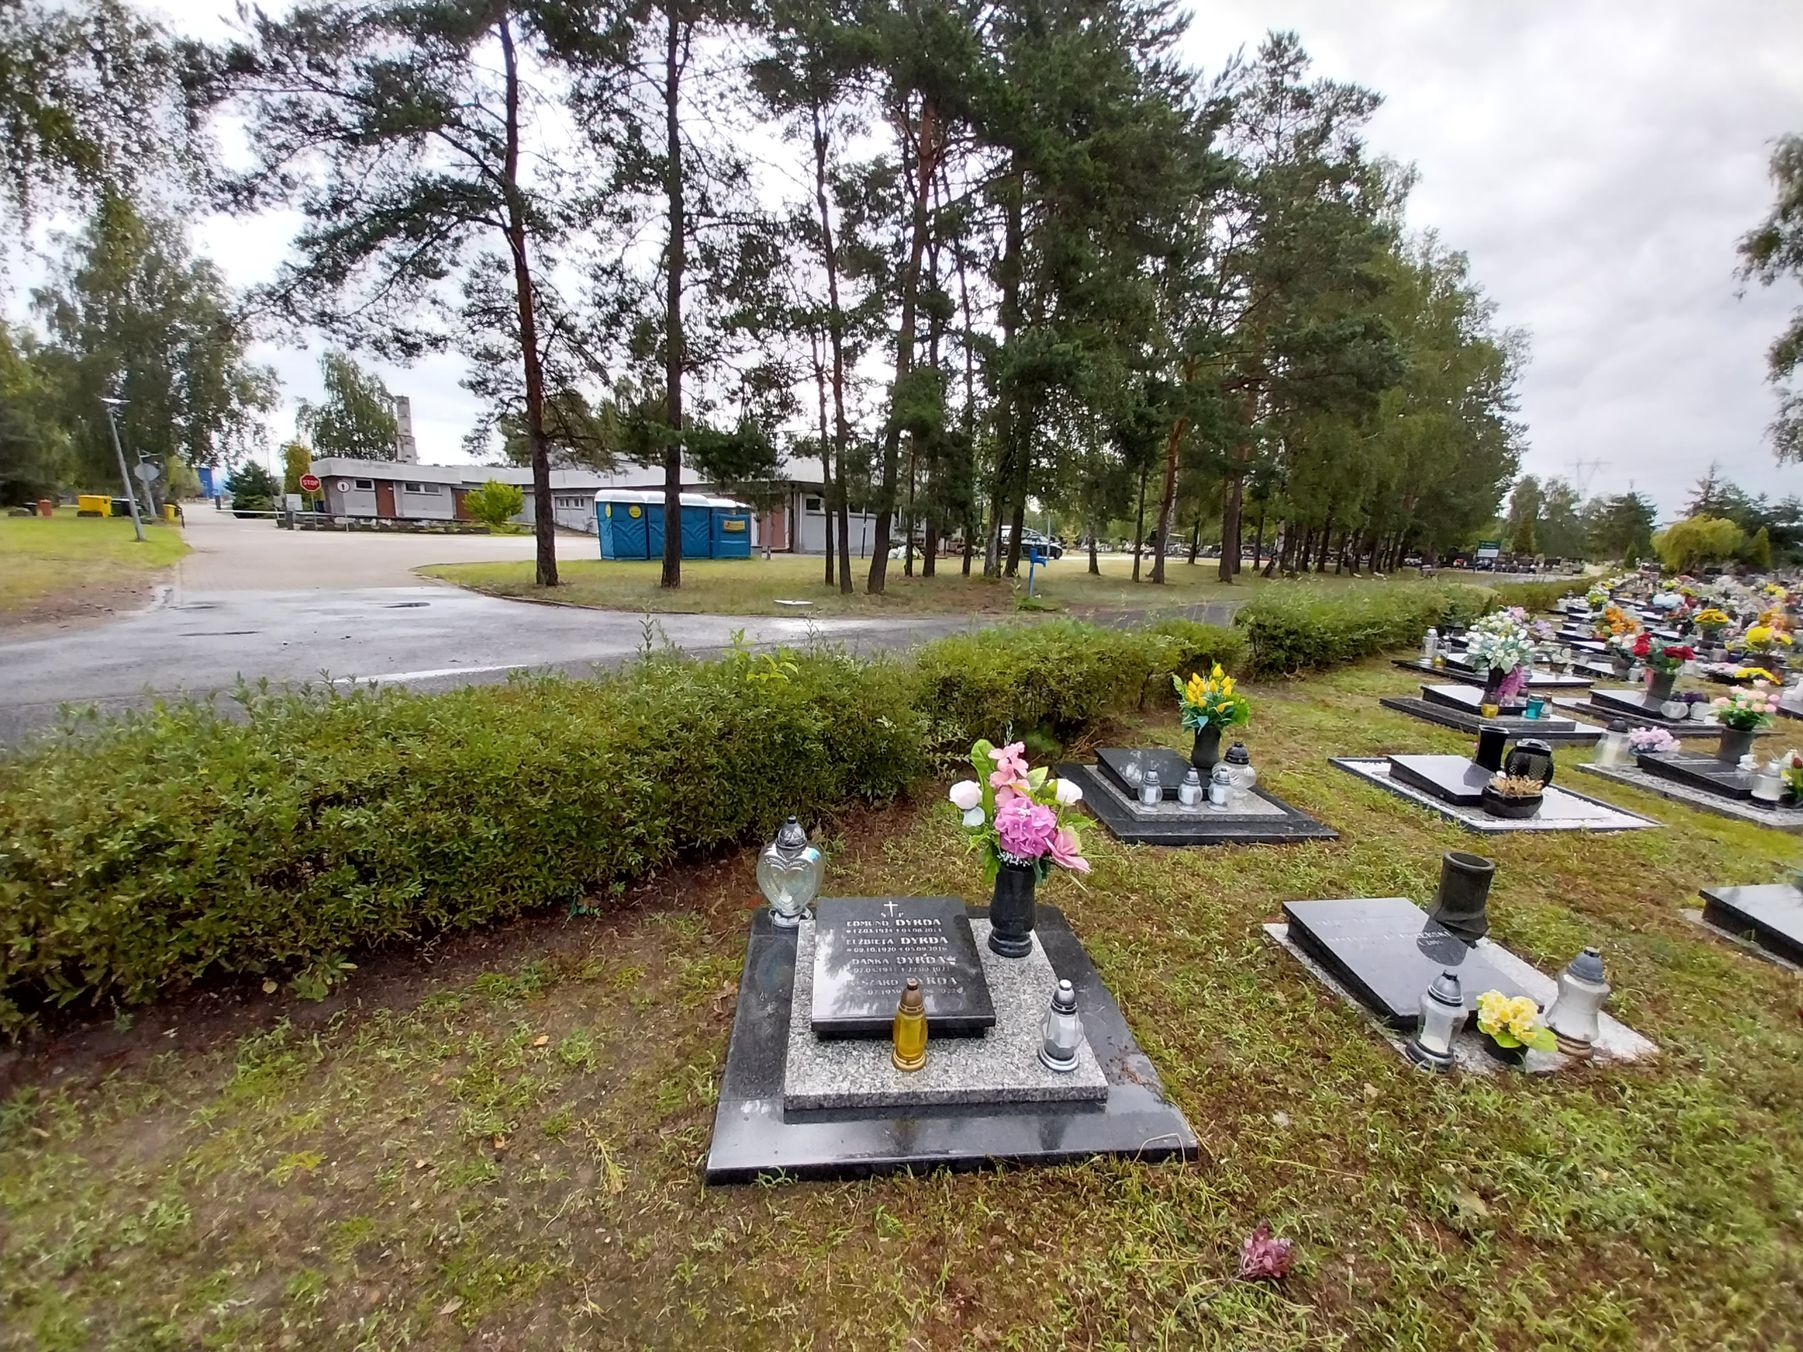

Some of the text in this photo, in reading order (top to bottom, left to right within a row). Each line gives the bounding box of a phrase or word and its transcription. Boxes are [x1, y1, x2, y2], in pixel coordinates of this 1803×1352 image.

[846, 918, 941, 927] EDMUND DYRDA
[846, 936, 949, 945] ELŻBIETA DYRDA
[896, 956, 946, 965] DYRDA
[908, 976, 958, 985] YRDA
